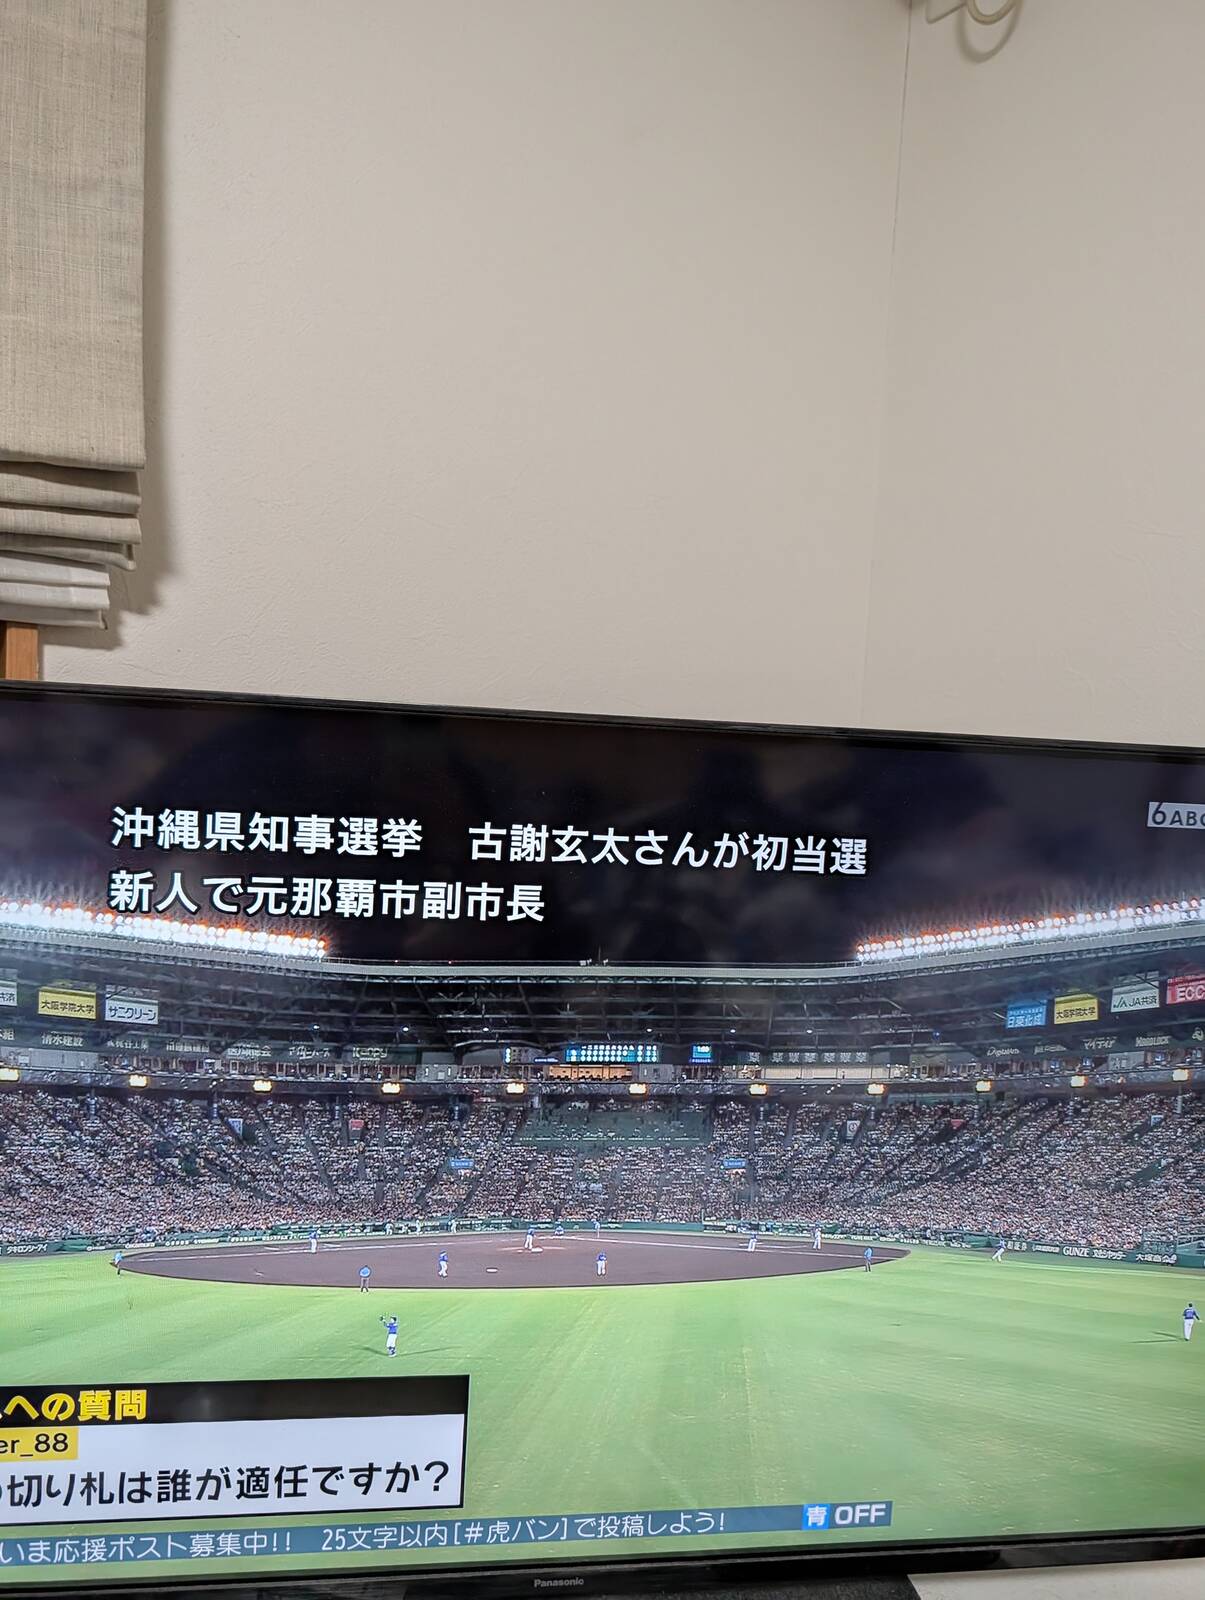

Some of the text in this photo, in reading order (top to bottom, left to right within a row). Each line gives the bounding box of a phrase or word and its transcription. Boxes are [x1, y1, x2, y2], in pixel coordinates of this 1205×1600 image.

[111, 806, 868, 876] 沖縄県知事選挙 古謝玄太さんが初当選
[109, 870, 545, 922] 新人で元那覇市副市長
[108, 1006, 157, 1021] サニクリーン
[1062, 1246, 1090, 1258] GUNZE
[0, 1389, 147, 1421] への質問
[0, 1460, 450, 1508] 切り札は誰が適任ですか?
[806, 1503, 887, 1527] 青 OFF
[533, 1576, 585, 1588] Panasonic
